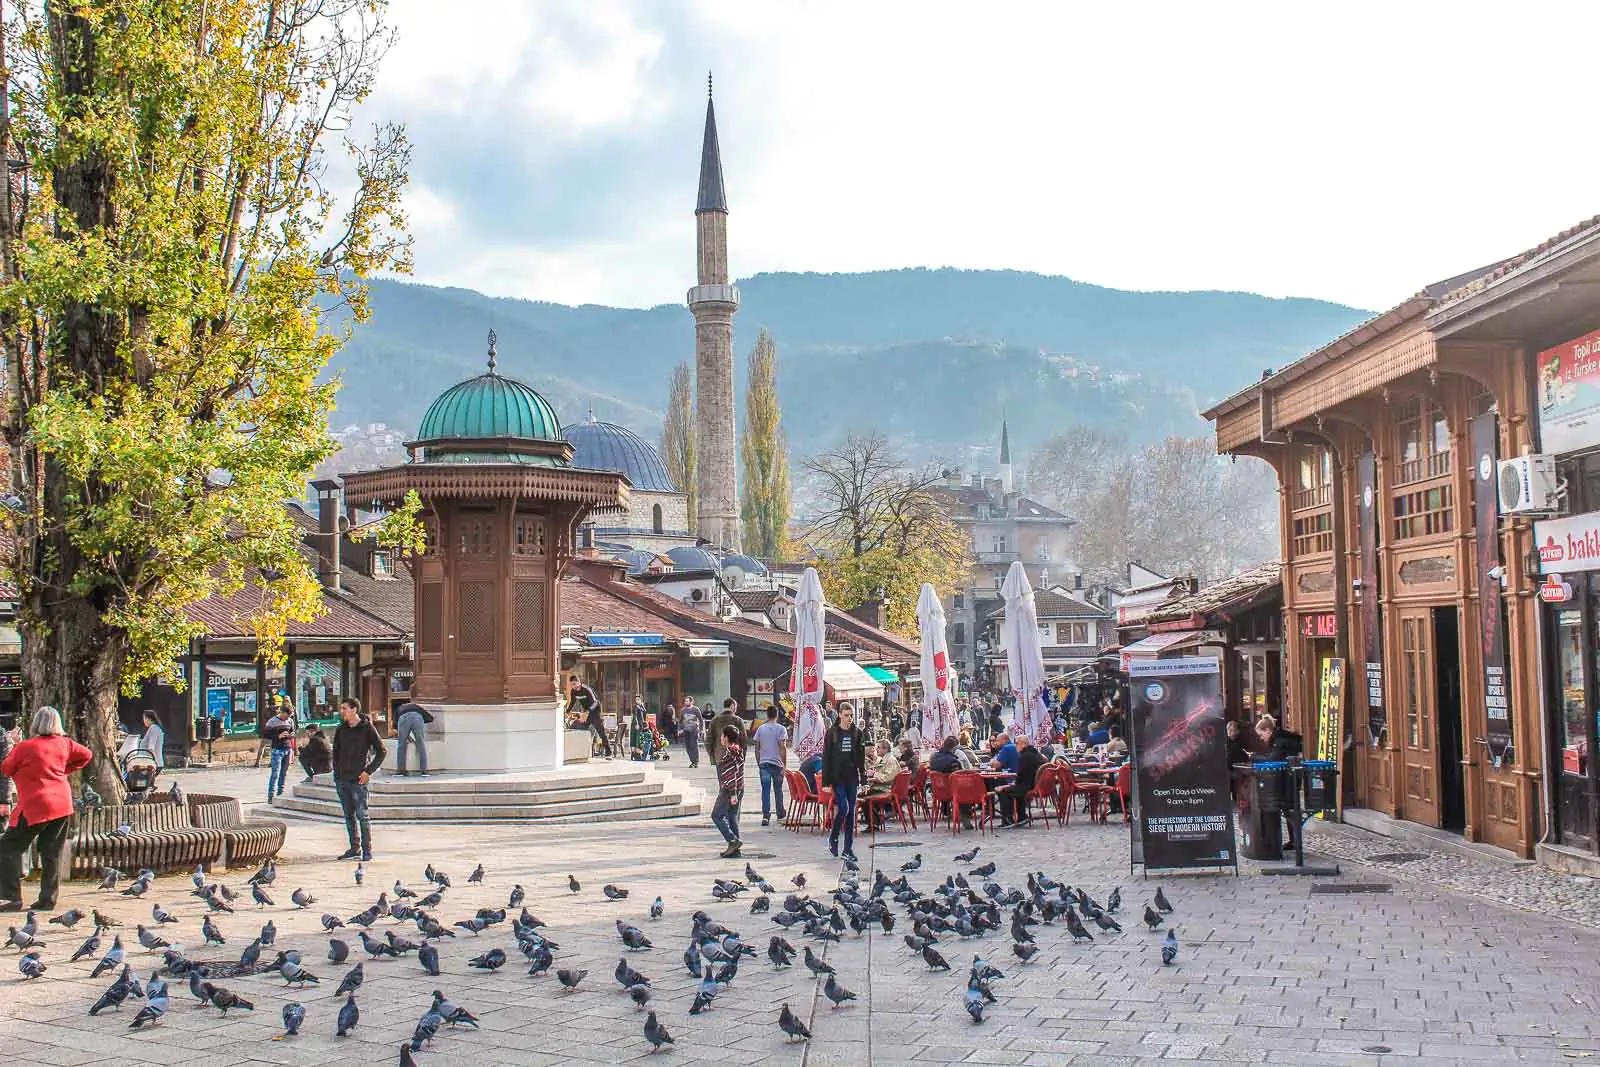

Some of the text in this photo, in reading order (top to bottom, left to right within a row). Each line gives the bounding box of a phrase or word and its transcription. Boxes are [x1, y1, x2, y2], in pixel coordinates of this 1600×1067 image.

[1567, 527, 1600, 560] bakl
[208, 674, 248, 687] apoteka
[1153, 789, 1171, 797] Open
[1175, 788, 1190, 796] Days
[1148, 817, 1158, 825] THE
[1158, 815, 1186, 824] PROJECTION
[1194, 815, 1204, 823] THE
[1204, 814, 1226, 823] LONGEST
[1148, 822, 1226, 833] SIEGE IN MODERN HISTORY
